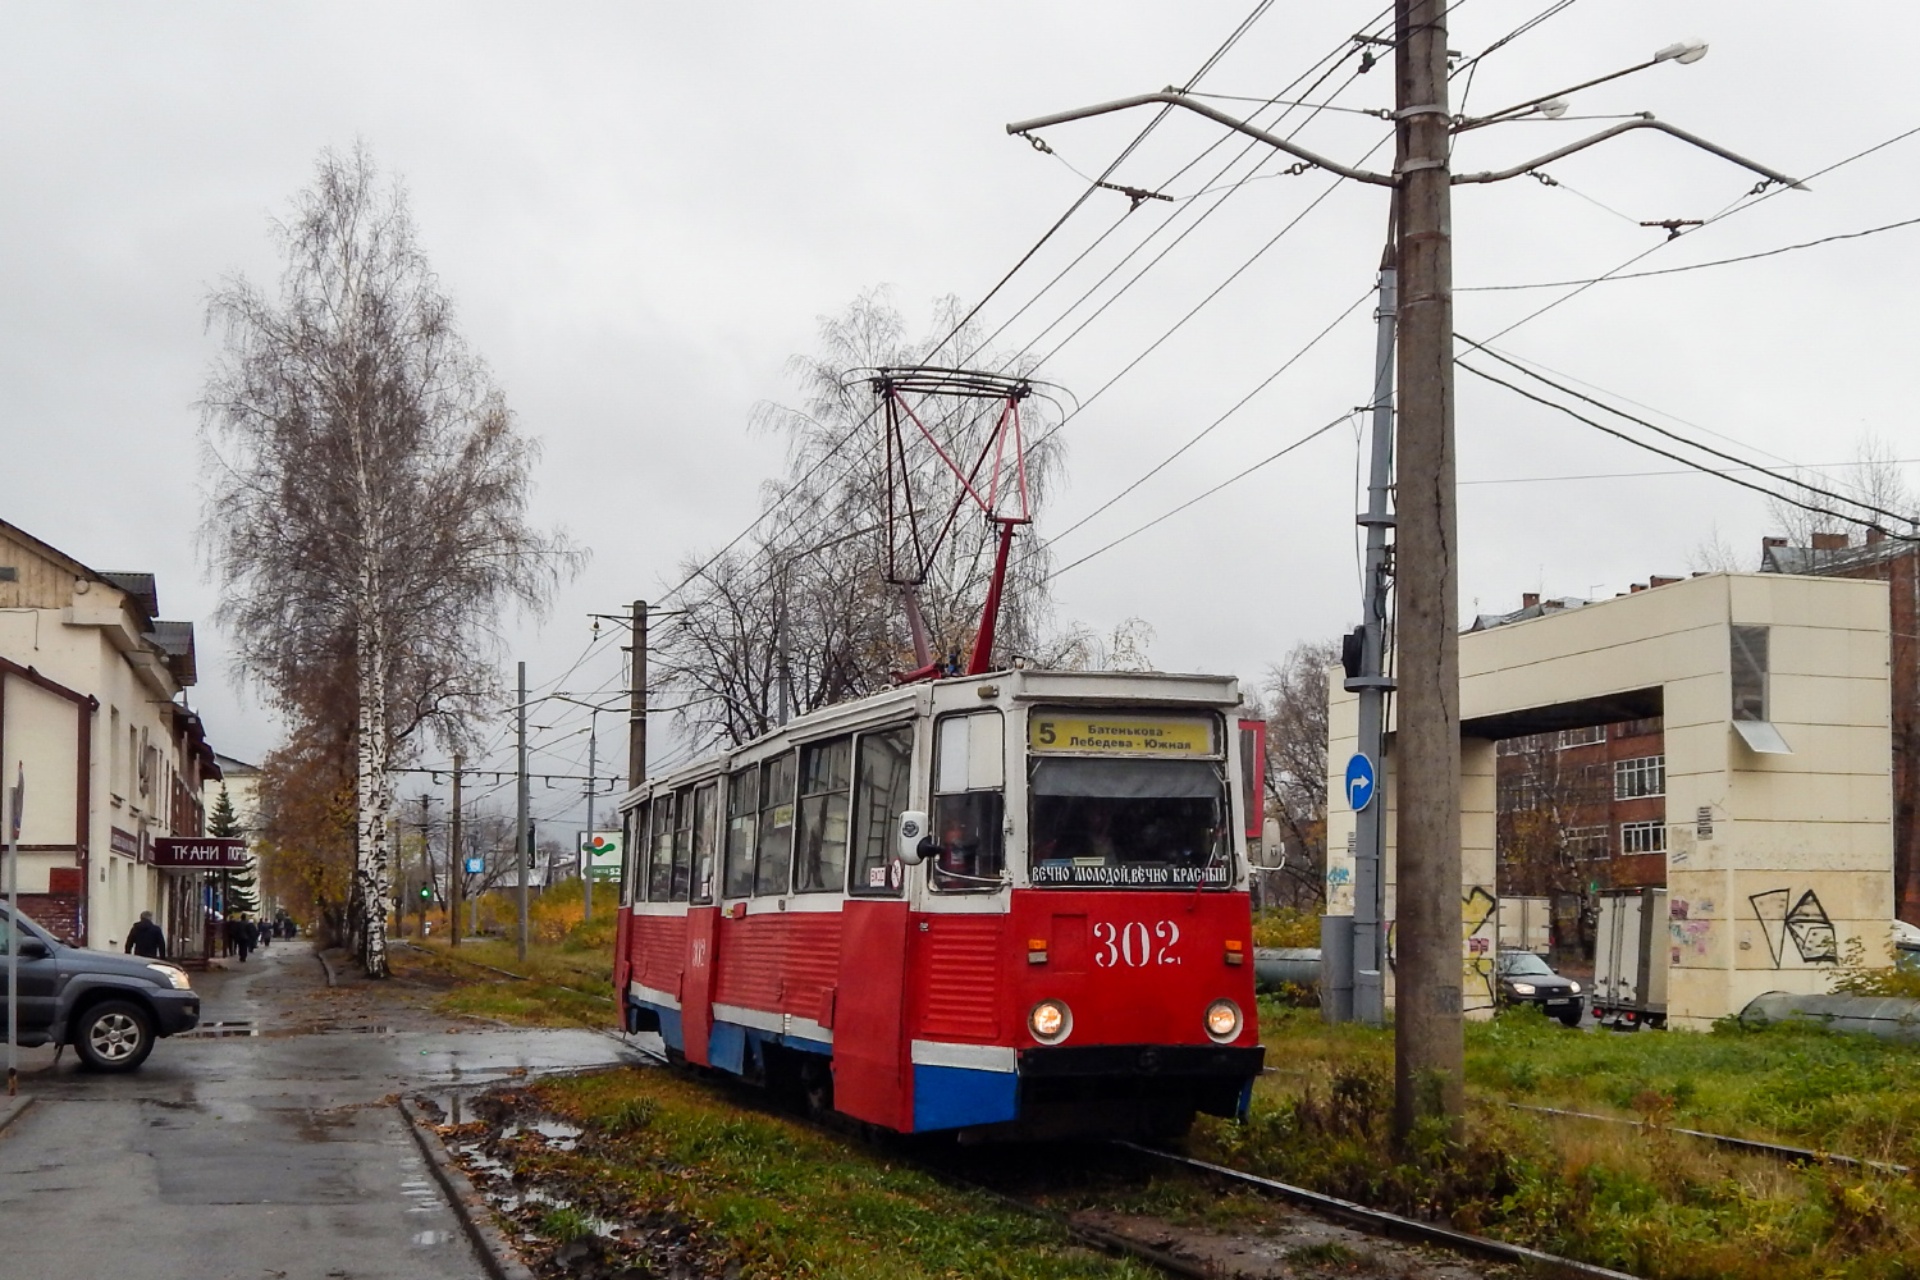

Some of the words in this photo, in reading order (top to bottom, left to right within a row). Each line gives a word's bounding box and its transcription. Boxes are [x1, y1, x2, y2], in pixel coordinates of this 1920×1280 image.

[1039, 722, 1057, 744] 5
[1087, 724, 1163, 737] Батенькова
[1070, 736, 1133, 749] Лебедева
[1144, 739, 1191, 750] Южная
[171, 845, 220, 860] ТКАНИ
[1032, 866, 1070, 882] ВЕЧНО
[1093, 920, 1181, 967] 302
